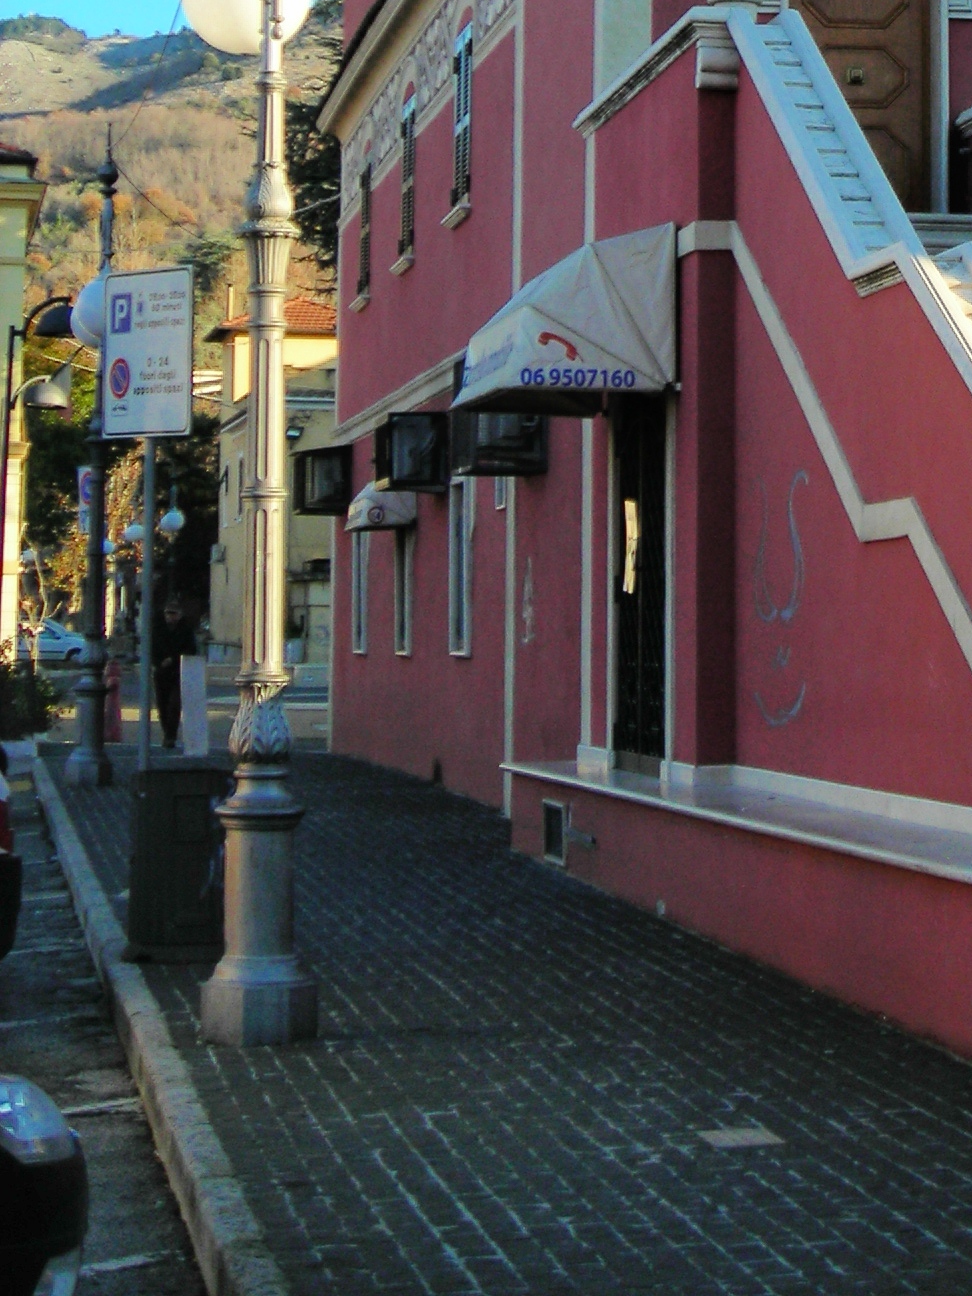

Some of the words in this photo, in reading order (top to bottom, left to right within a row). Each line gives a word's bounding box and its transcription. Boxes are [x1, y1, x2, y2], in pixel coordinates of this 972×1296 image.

[115, 298, 128, 330] P
[159, 356, 169, 368] 24
[139, 371, 156, 381] fuori
[520, 368, 545, 386] 06
[549, 368, 636, 388] 9507160
[133, 384, 162, 396] appositi
[163, 384, 183, 395] spazi
